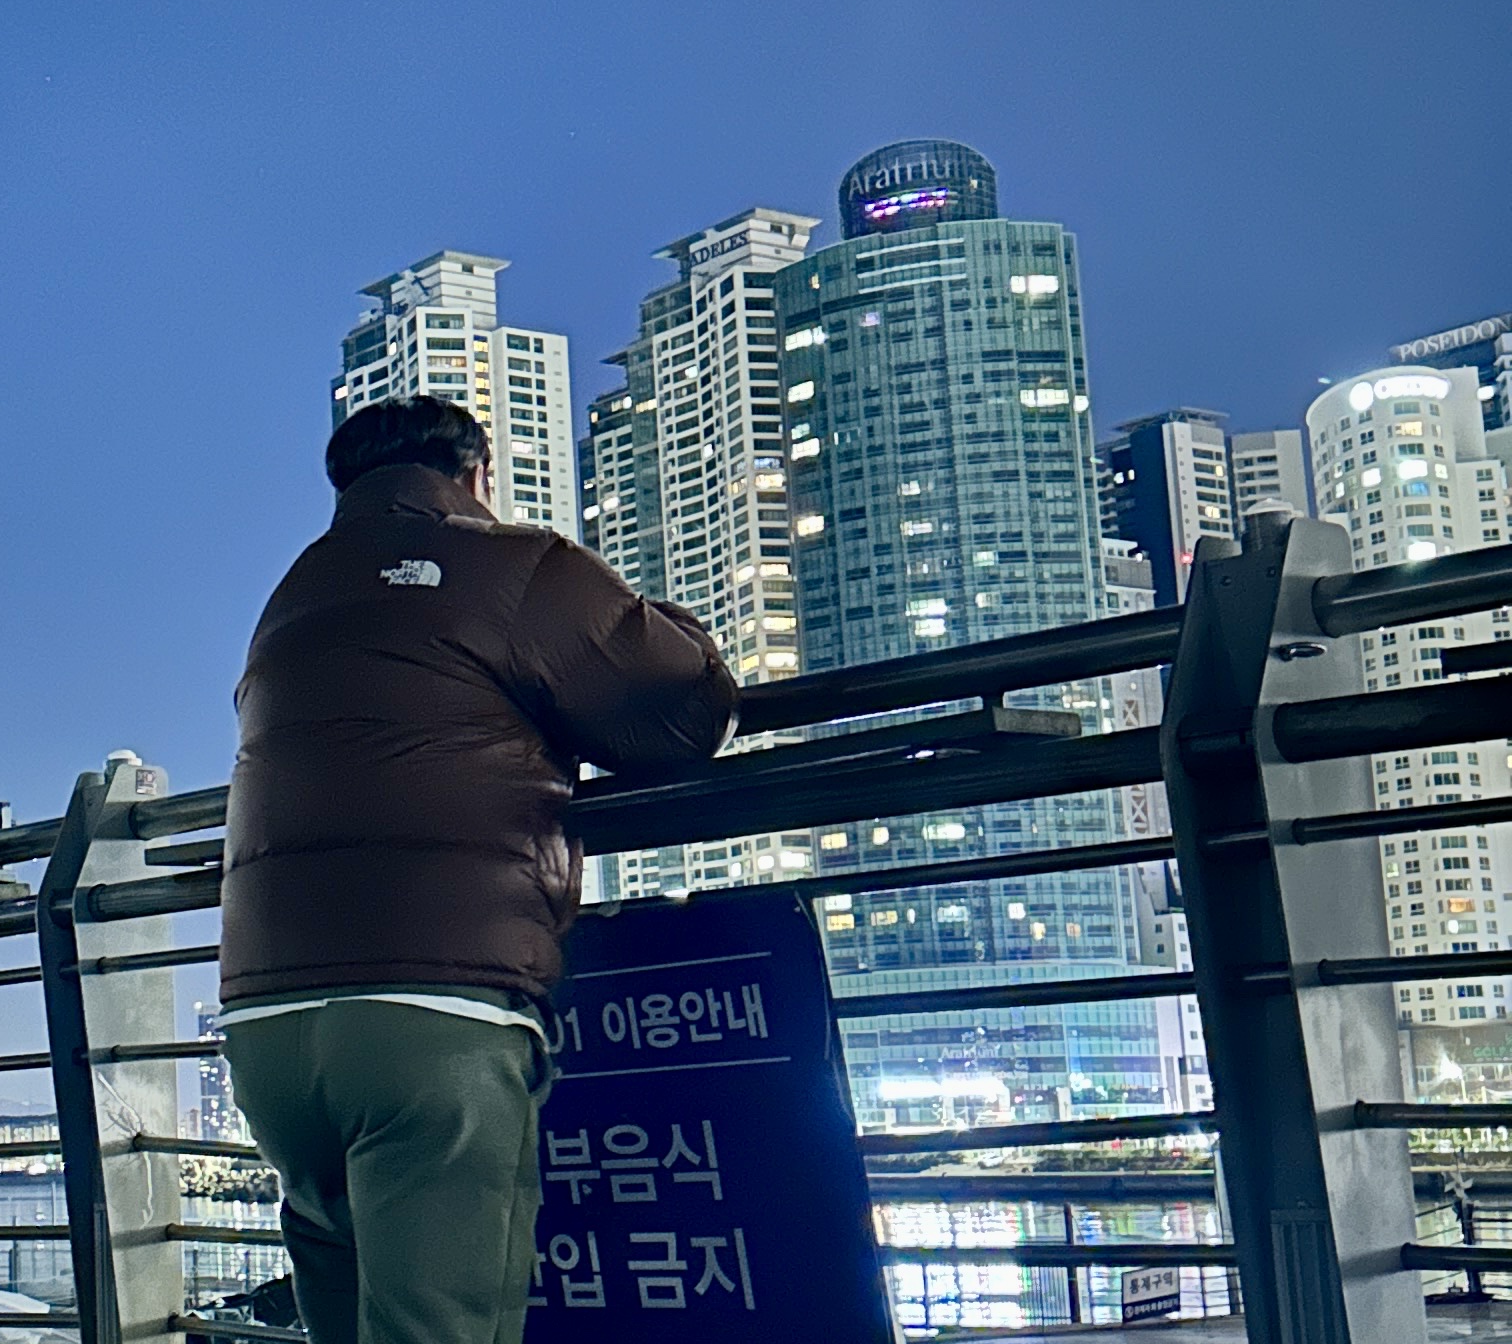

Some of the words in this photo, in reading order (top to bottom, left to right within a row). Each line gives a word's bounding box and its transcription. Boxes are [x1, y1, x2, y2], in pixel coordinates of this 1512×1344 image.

[848, 152, 960, 202] Aratriu
[1399, 312, 1512, 362] POSEIDON
[600, 982, 769, 1050] 이용안내
[538, 1119, 724, 1205] 부음식
[627, 1227, 756, 1312] 금지
[1129, 1270, 1173, 1294] 통제구역
